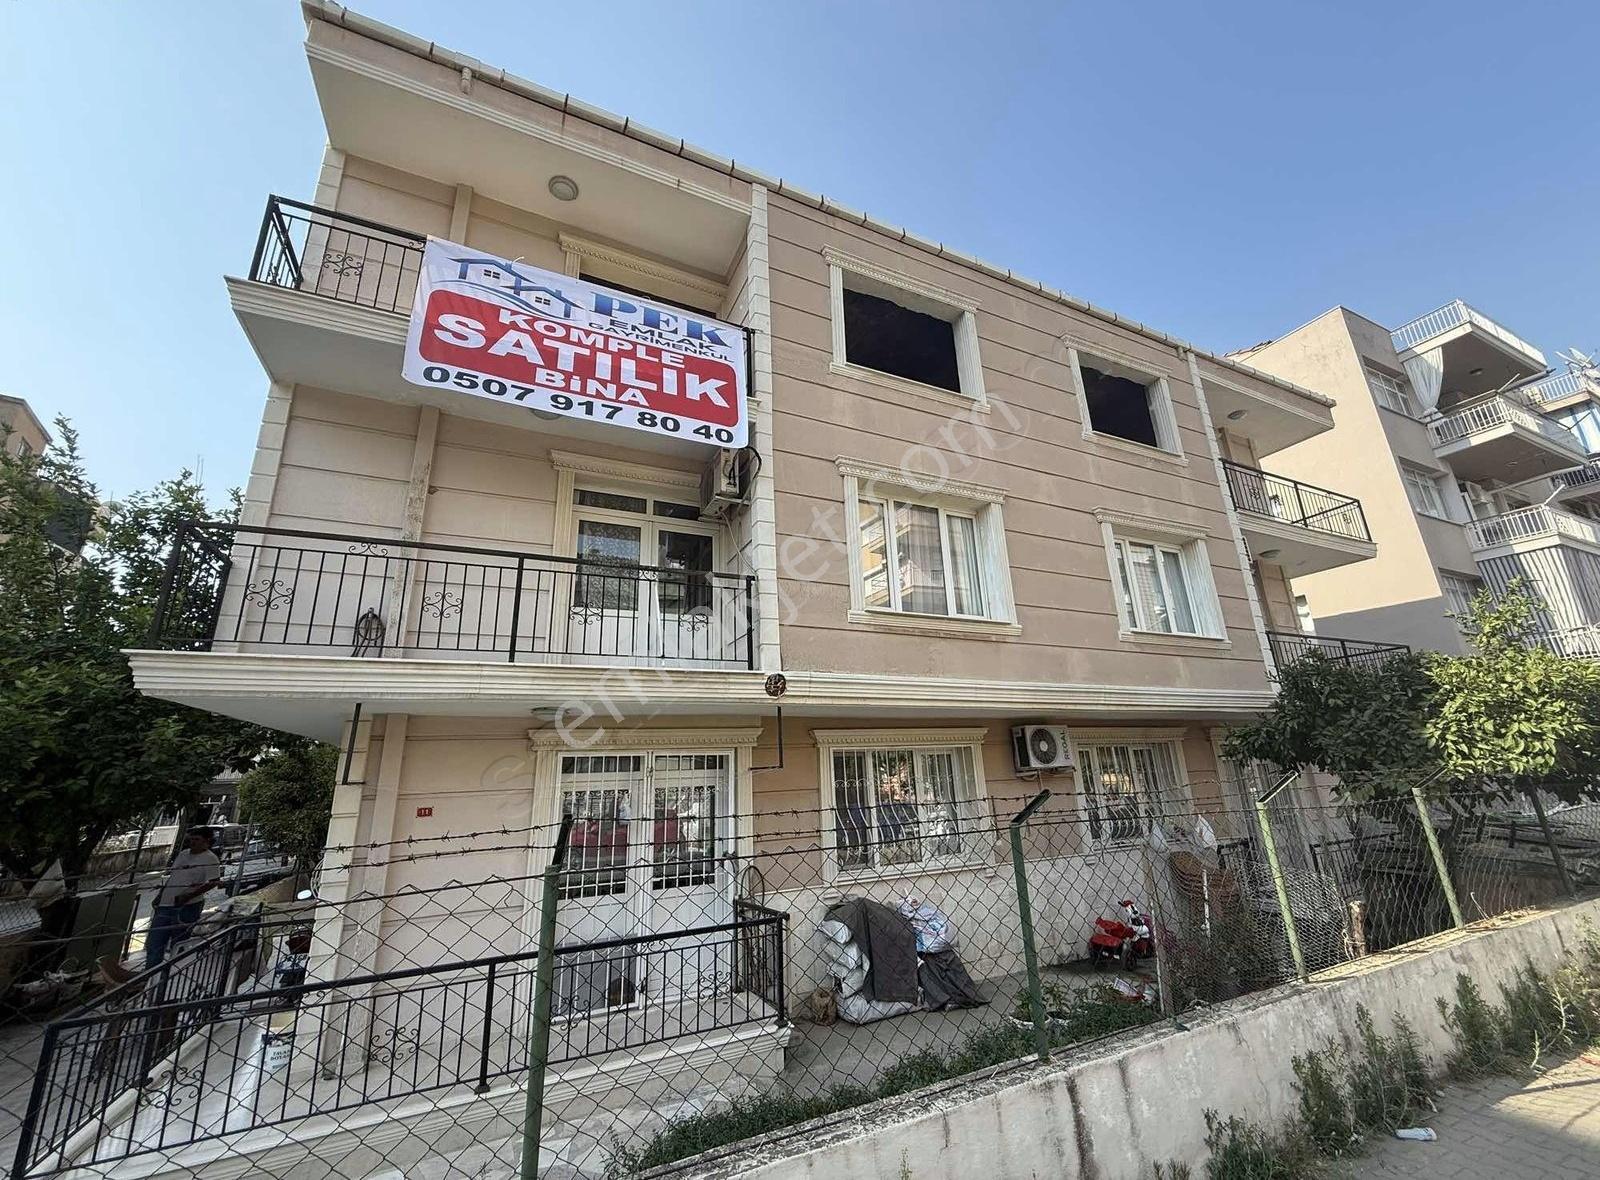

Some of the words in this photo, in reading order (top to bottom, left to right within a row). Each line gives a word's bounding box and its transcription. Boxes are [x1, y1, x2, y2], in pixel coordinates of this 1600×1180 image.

[499, 308, 685, 368] KOMPLE
[591, 290, 732, 349] PEK
[609, 318, 717, 352] EMLAK
[433, 313, 731, 409] SATILIK
[422, 366, 536, 402] 0507
[549, 393, 624, 421] 917
[636, 411, 681, 433] 80
[692, 424, 735, 444] 40
